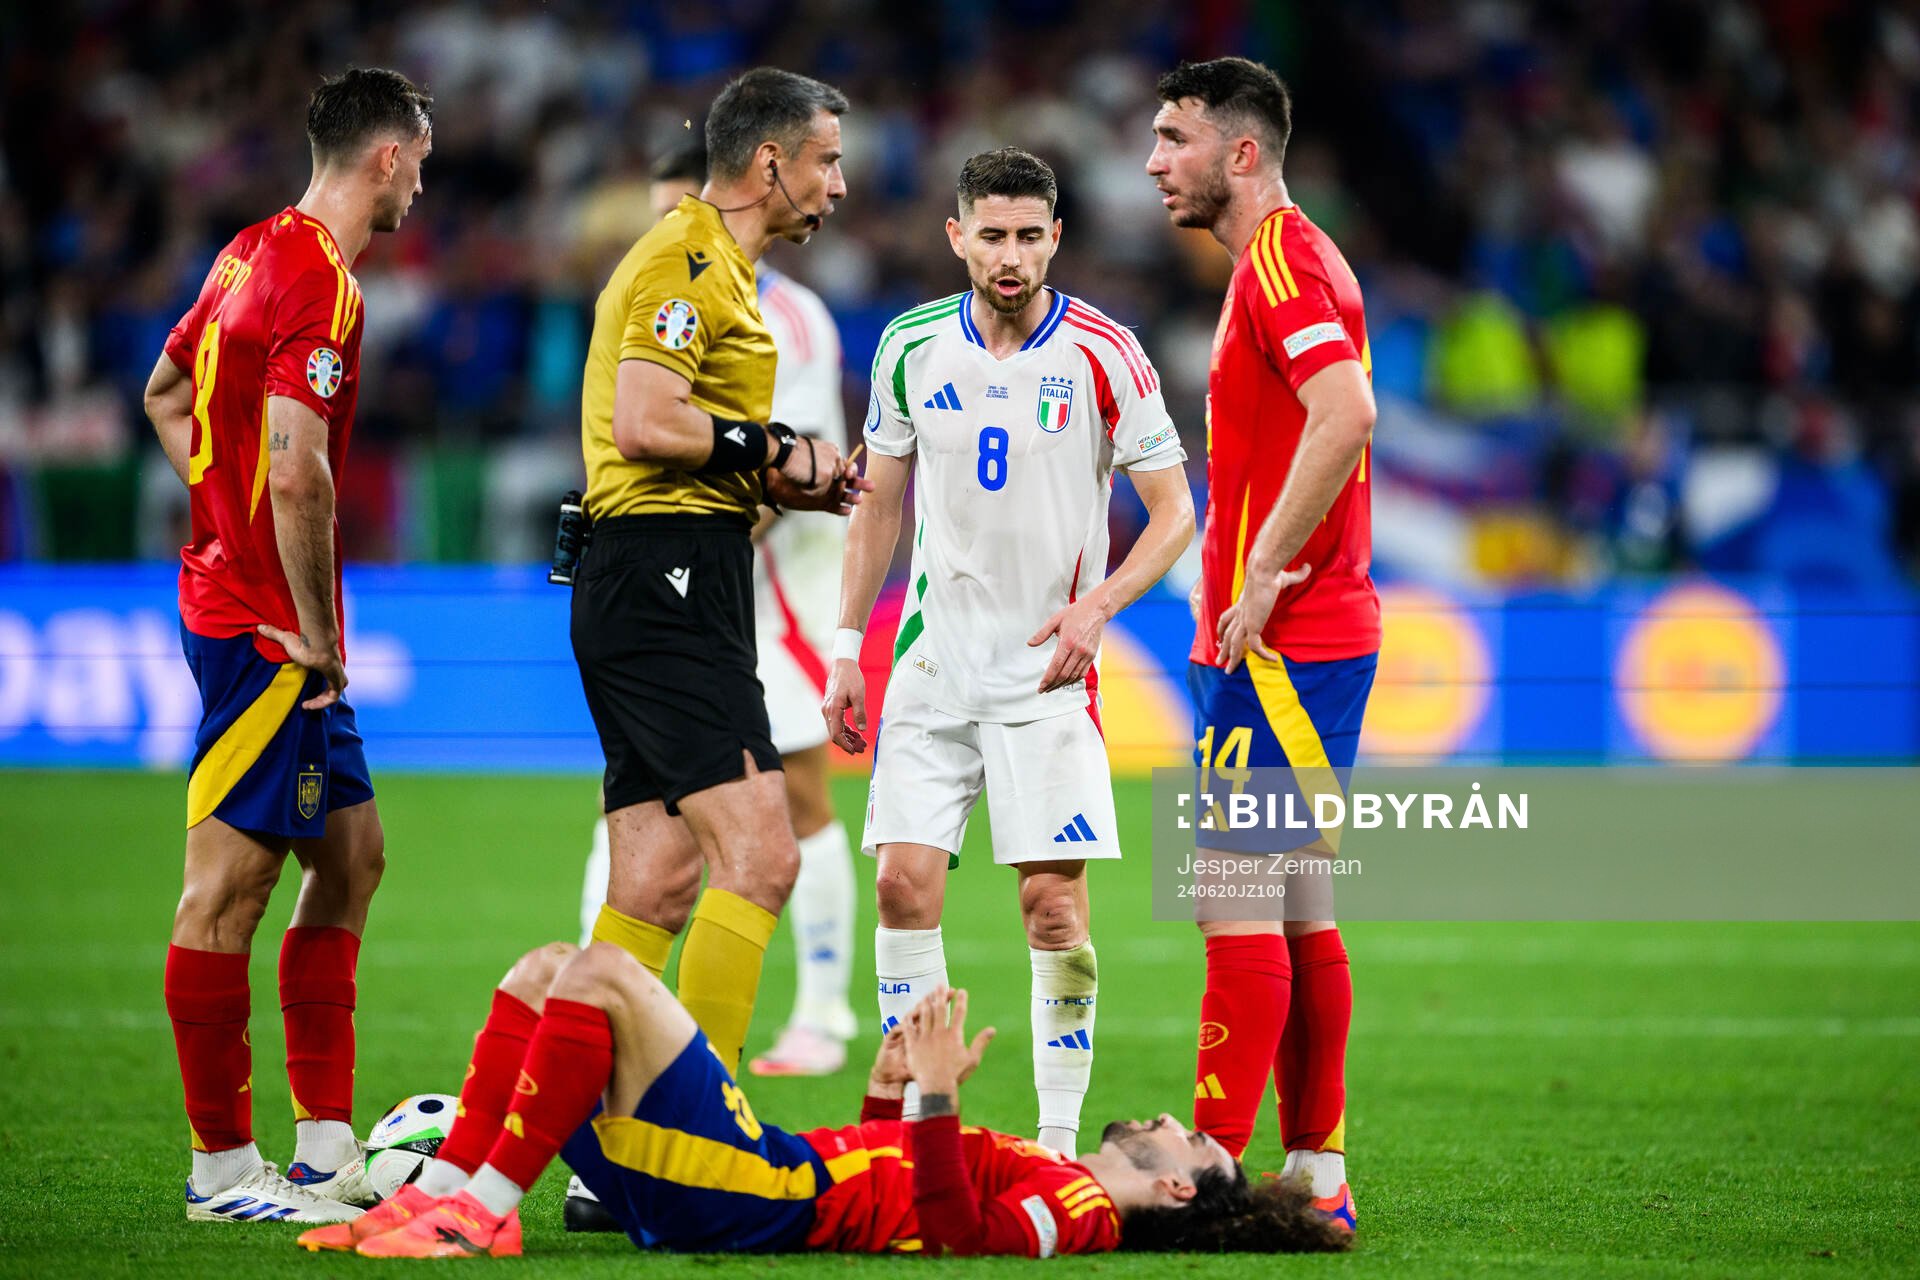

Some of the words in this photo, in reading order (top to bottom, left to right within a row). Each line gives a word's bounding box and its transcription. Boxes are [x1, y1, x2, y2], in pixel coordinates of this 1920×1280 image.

[1042, 387, 1069, 399] ITALIA
[977, 426, 1009, 491] 8
[1198, 726, 1253, 794] 14
